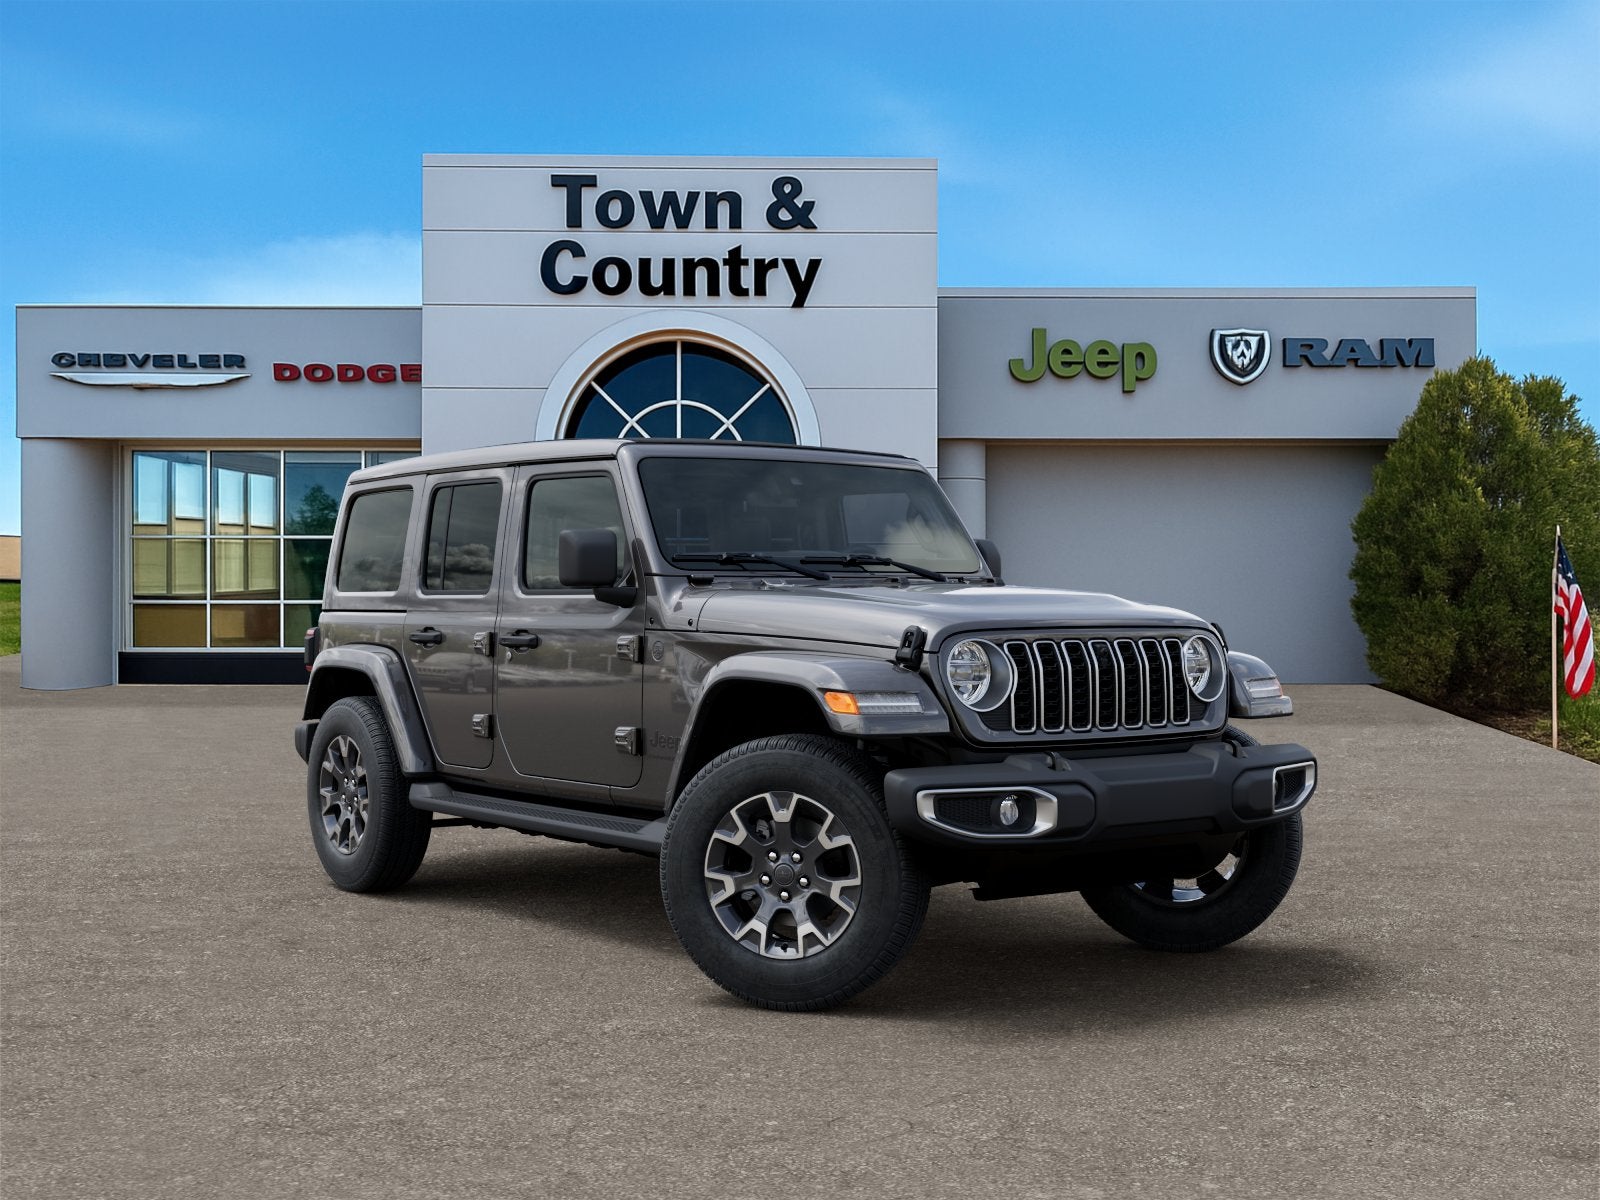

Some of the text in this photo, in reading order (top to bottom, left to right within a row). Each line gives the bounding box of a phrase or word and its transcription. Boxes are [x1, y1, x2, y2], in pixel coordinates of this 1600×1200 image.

[551, 174, 818, 229] Town &
[540, 239, 822, 308] Country
[273, 363, 422, 383] DODGE
[1009, 328, 1158, 393] Jeep
[1283, 338, 1435, 367] RAM
